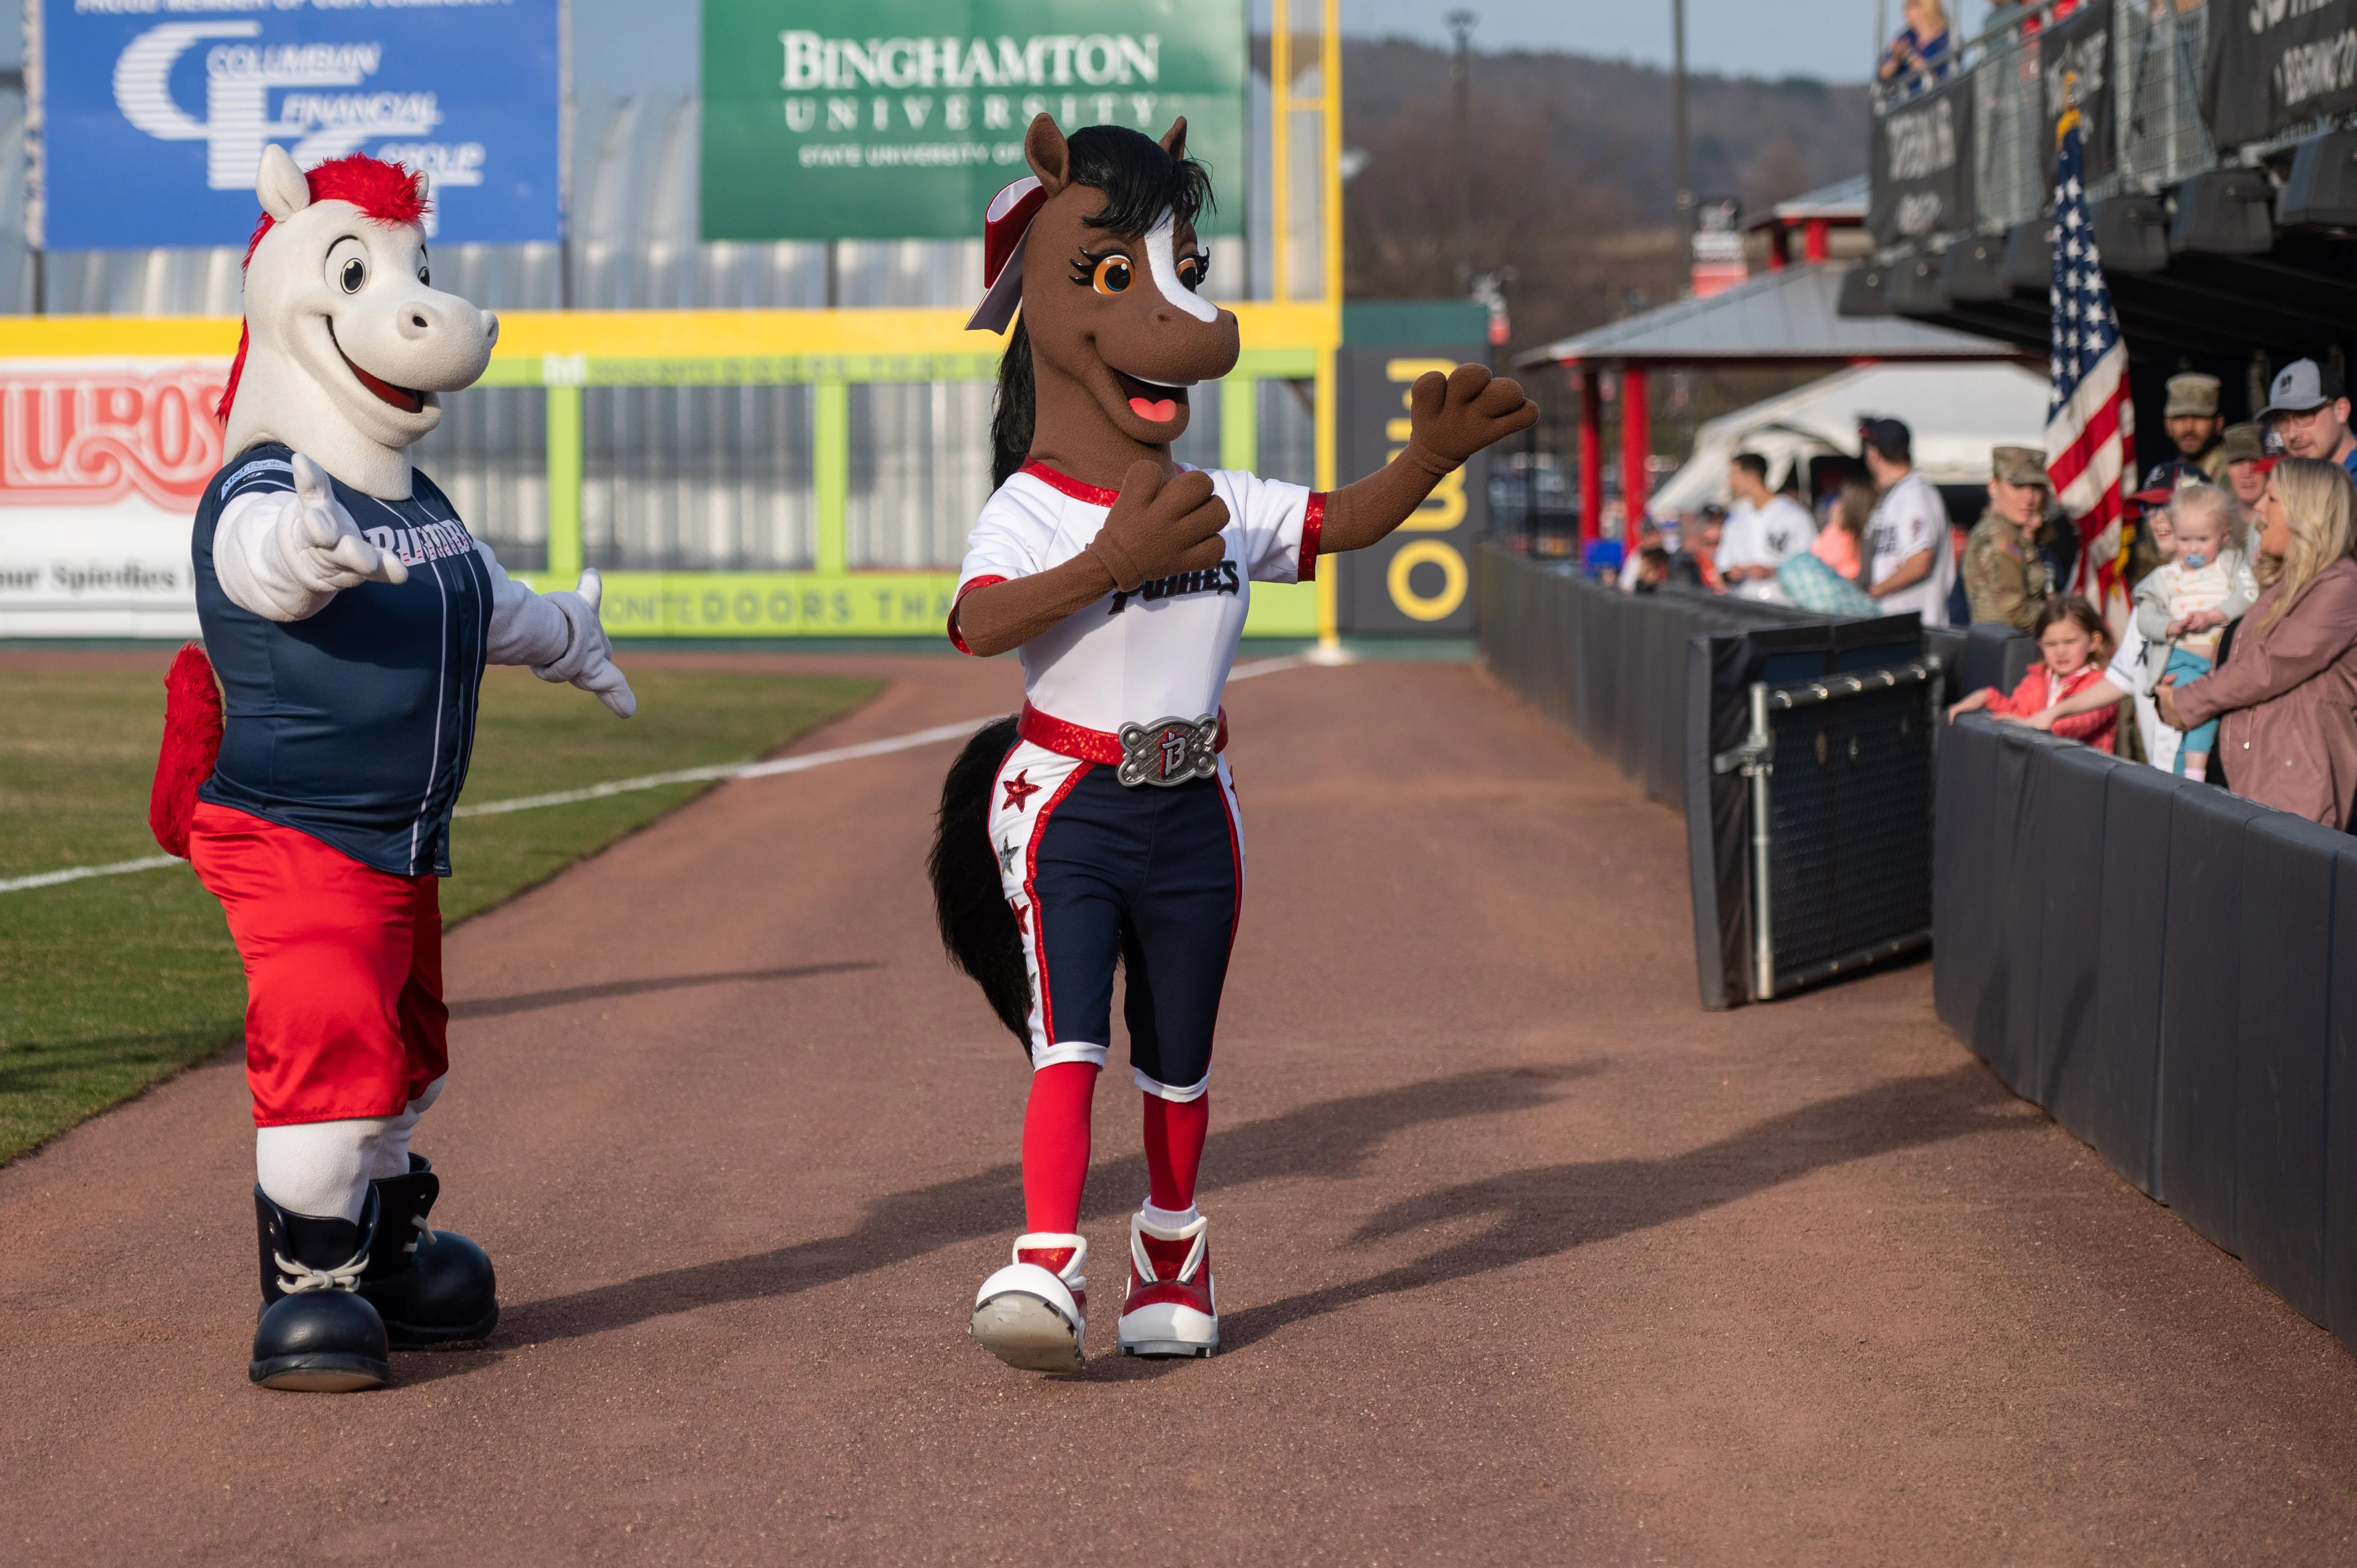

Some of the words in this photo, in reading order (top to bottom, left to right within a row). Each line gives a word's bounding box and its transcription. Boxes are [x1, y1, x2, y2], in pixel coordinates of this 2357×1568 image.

[207, 44, 381, 78] COLUMBIAN
[781, 30, 1160, 90] BINGHAMTON
[282, 93, 444, 126] FINANCIAL
[784, 93, 1157, 133] UNIVERSITY
[799, 143, 863, 167] STATE
[866, 143, 989, 166] UNIVERSITY
[249, 461, 280, 469] Bank
[701, 590, 851, 624] DOORS
[875, 589, 956, 621] THA
